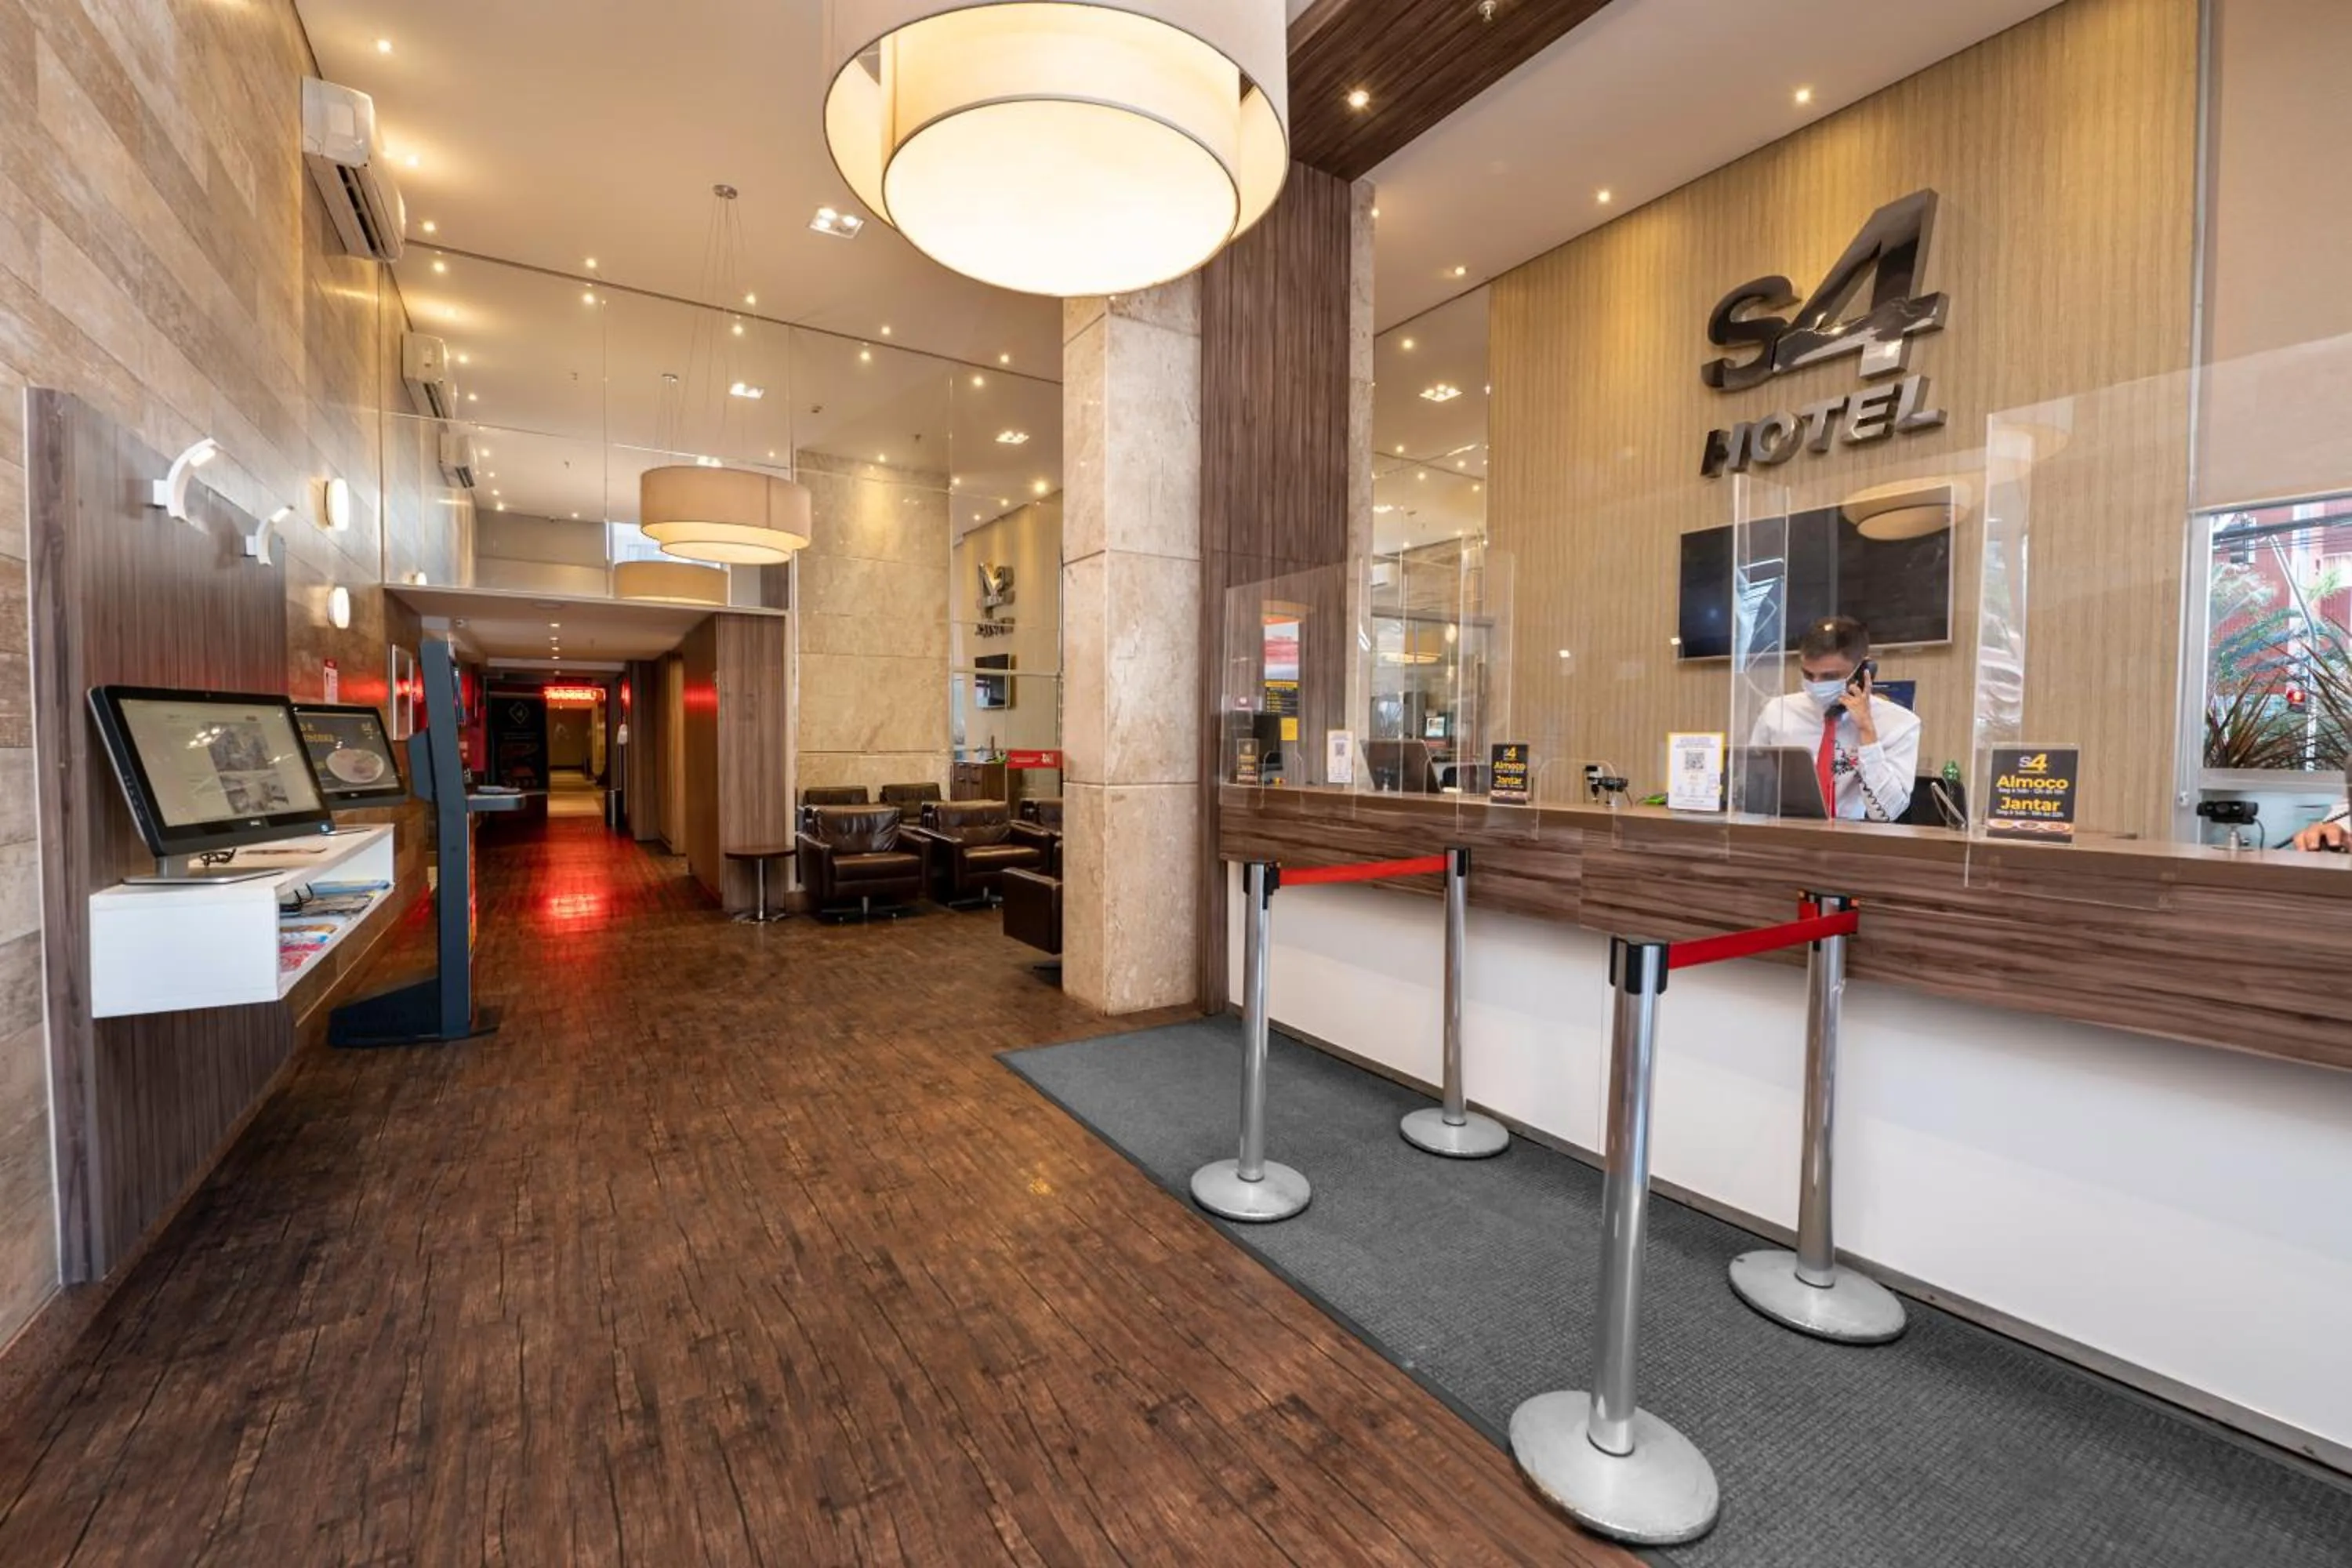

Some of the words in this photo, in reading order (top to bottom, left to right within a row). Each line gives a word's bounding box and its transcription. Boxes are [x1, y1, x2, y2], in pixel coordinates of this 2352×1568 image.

[1701, 188, 1949, 392] S4
[1700, 375, 1945, 478] HOTEL
[2019, 753, 2047, 771] S4
[2000, 797, 2061, 812] Jantar
